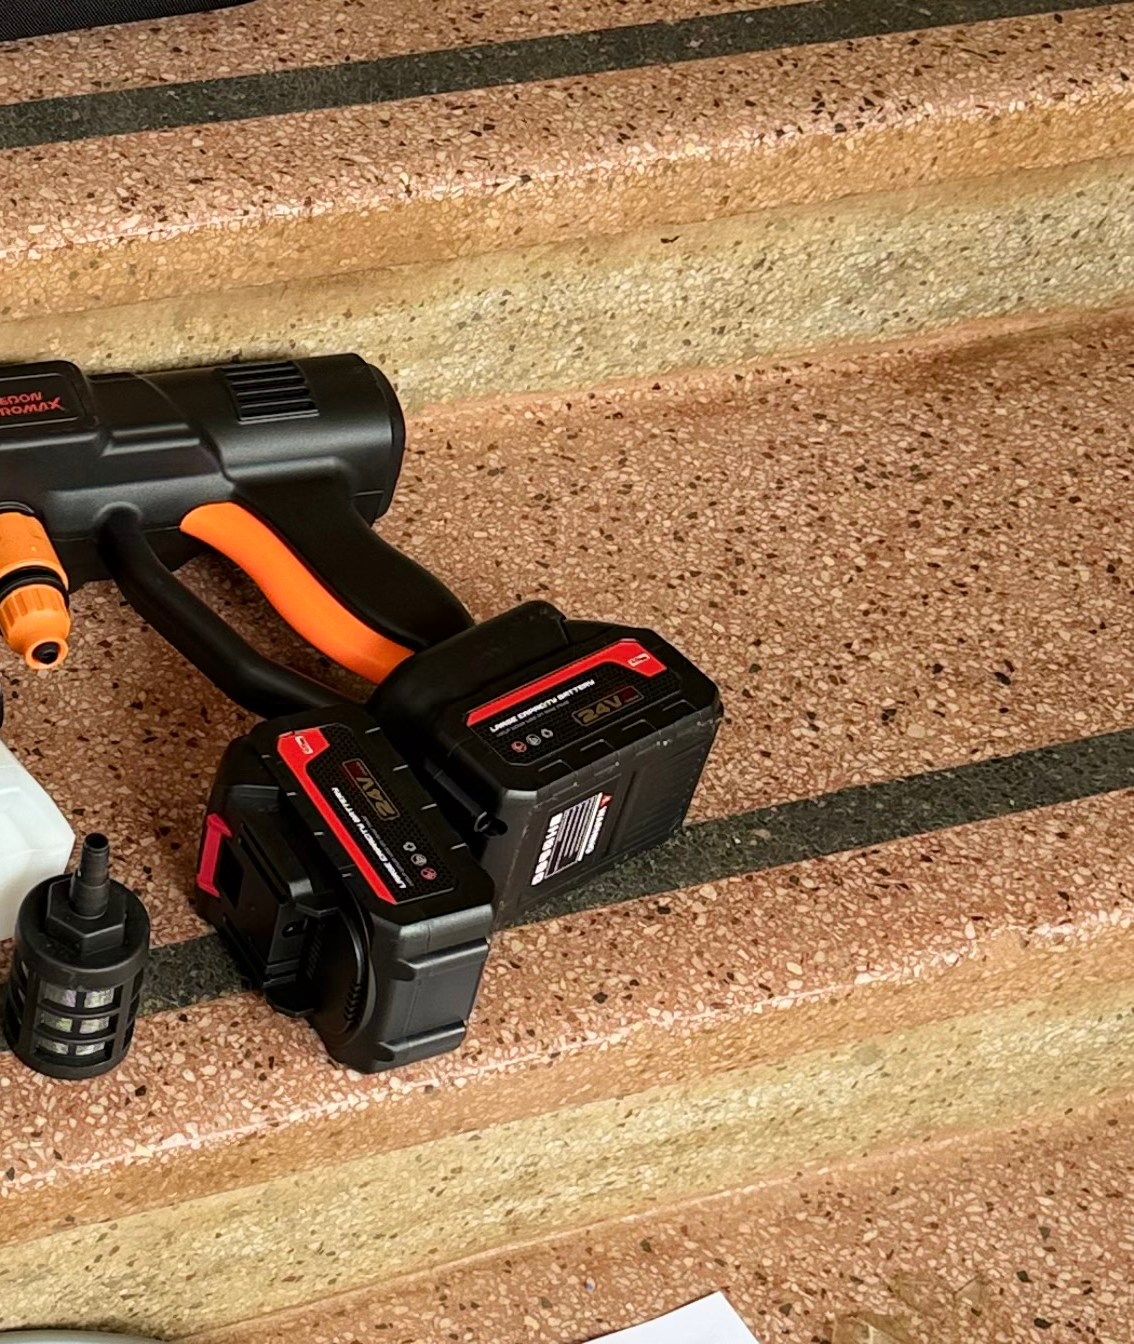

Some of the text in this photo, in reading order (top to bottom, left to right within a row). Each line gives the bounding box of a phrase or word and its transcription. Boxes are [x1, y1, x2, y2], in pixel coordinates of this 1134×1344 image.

[489, 715, 518, 733] LARGE
[517, 697, 558, 719] CAPACITY
[556, 679, 596, 701] BATTERY
[577, 695, 623, 724] 24V
[356, 777, 396, 817] 24V
[383, 861, 407, 889] LARGE
